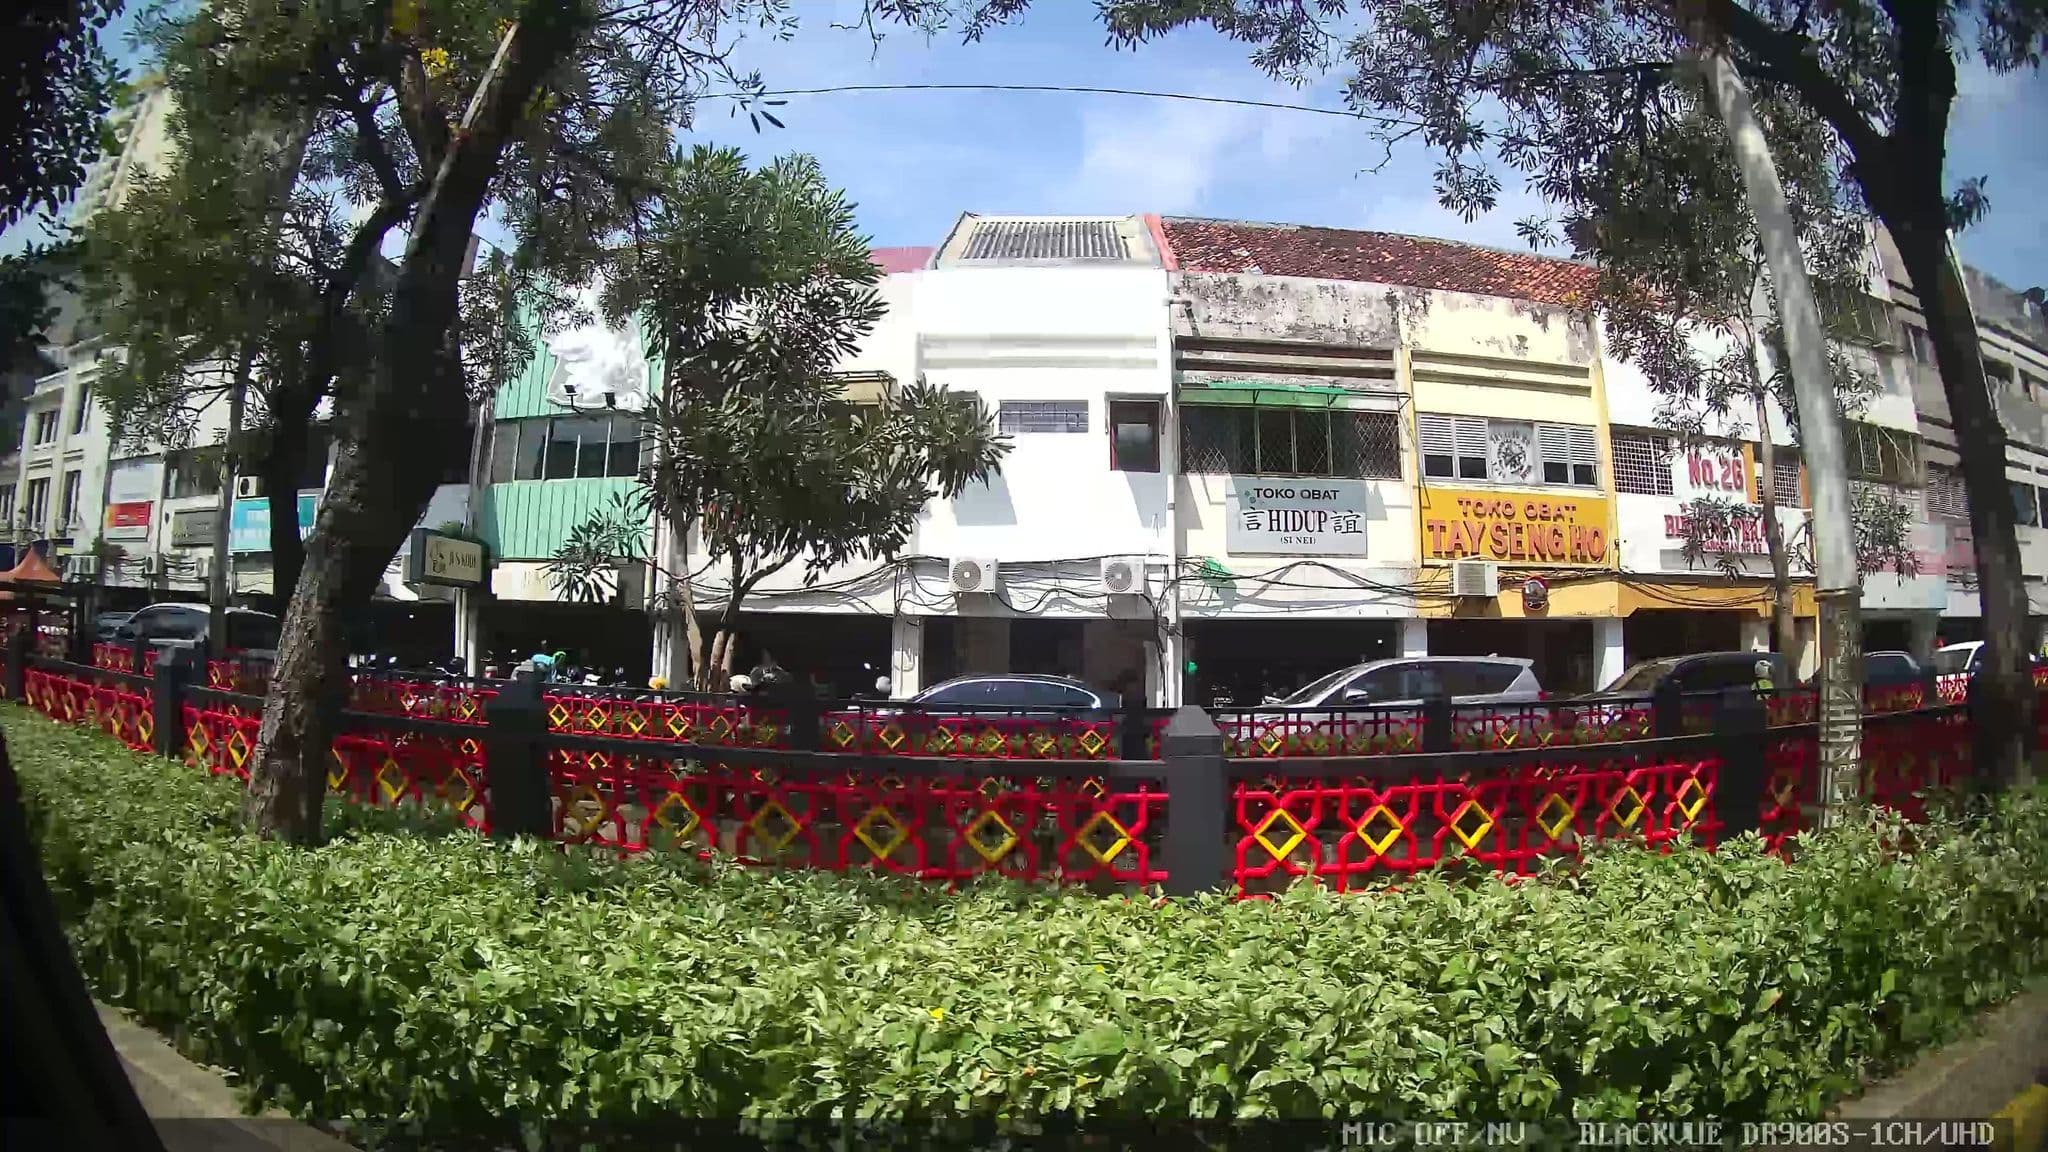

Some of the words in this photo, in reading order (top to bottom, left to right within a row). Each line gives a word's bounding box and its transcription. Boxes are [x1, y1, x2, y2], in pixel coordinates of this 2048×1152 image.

[1253, 487, 1296, 499] TOKO
[1300, 488, 1340, 500] OBAT
[1268, 509, 1328, 533] HIDUP
[1457, 497, 1516, 521] TOKO
[1524, 501, 1577, 524] OBAT
[1427, 519, 1486, 559] TAY
[1490, 522, 1566, 562] SENG
[1569, 525, 1607, 563] HO
